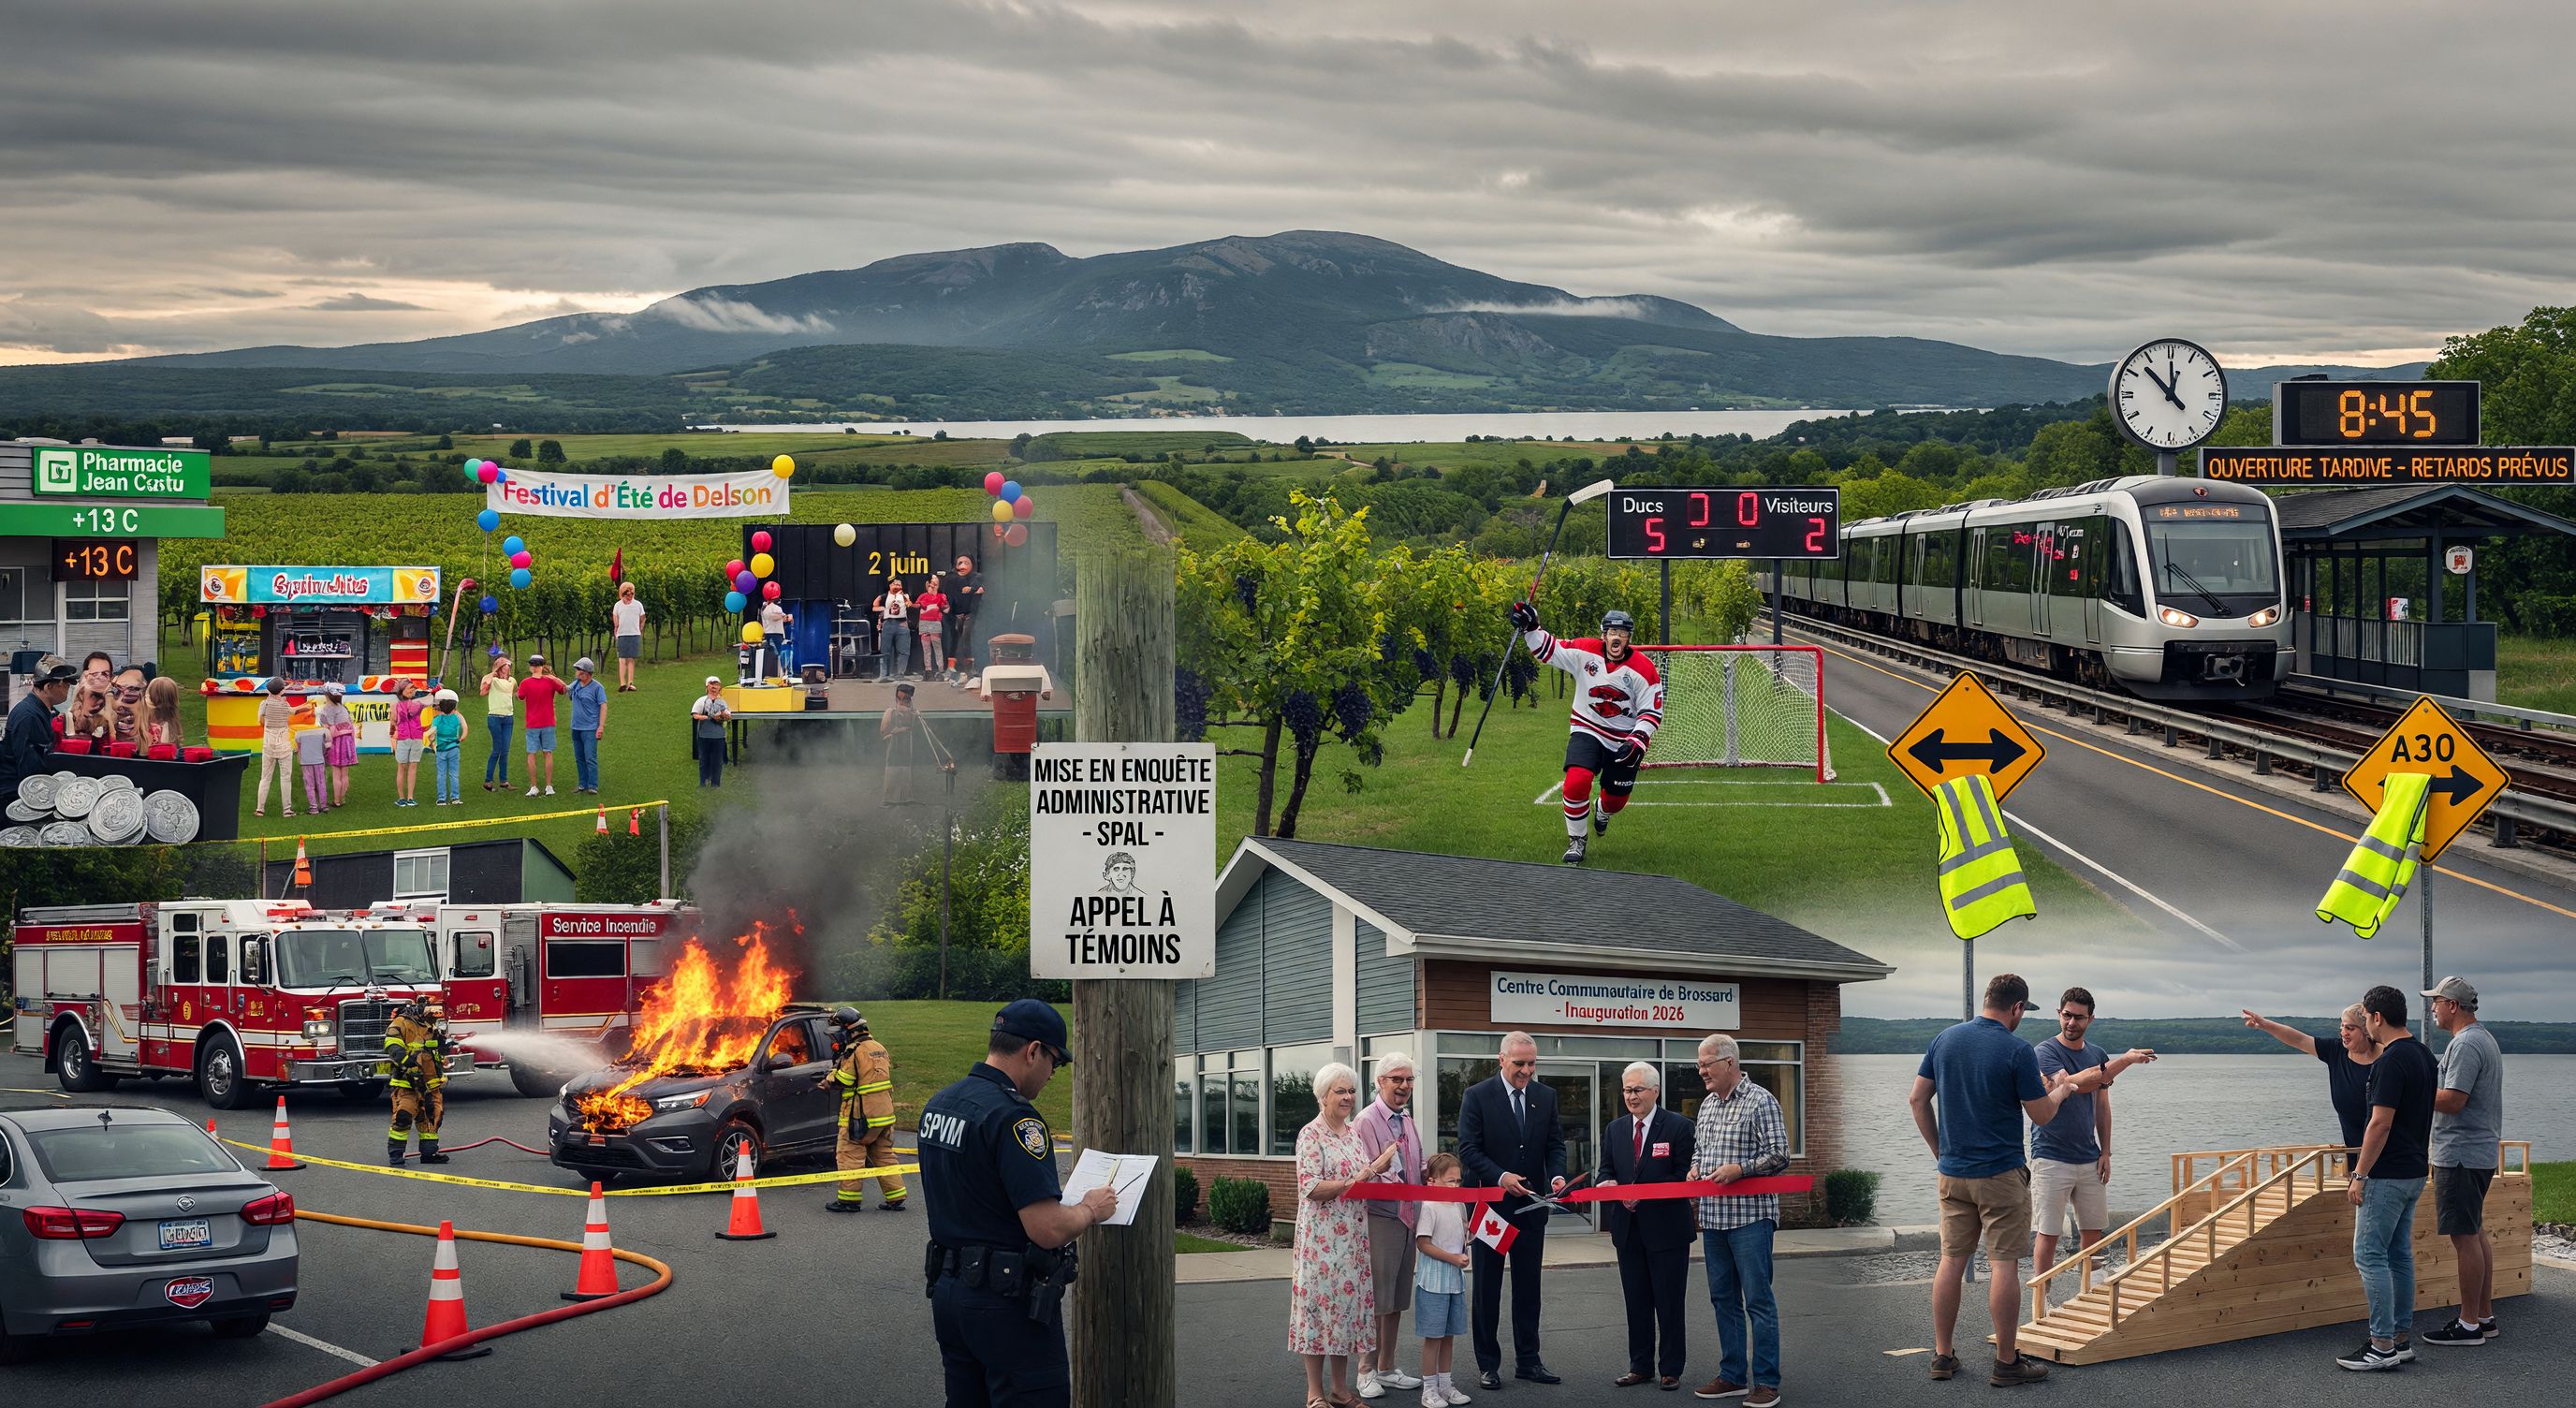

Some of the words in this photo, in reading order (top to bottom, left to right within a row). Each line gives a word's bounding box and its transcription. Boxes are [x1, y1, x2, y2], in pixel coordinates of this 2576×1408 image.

[2338, 389, 2437, 439] 8:45
[82, 451, 183, 474] Pharmacie
[2209, 457, 2312, 478] OUVERTURE
[2320, 456, 2393, 478] TARDIVE
[2411, 456, 2491, 477] RETARDS
[2498, 452, 2568, 478] PRÉVUS
[82, 472, 128, 491] Jean
[504, 480, 589, 507] Festival
[594, 480, 653, 509] d'Été
[659, 483, 687, 508] de
[694, 482, 772, 507] Delson
[1623, 497, 1663, 513] Ducs
[1764, 496, 1833, 514] Visiteurs
[72, 508, 115, 533] +13
[122, 508, 139, 533] C
[1646, 518, 1665, 551] 5
[1806, 517, 1825, 552] 2
[65, 546, 110, 577] +13
[116, 546, 133, 575] C
[869, 551, 882, 576] 2
[887, 550, 929, 581] juin
[2391, 733, 2455, 763] A30
[1034, 758, 1084, 783] MISE
[1090, 758, 1116, 783] EN
[1122, 754, 1211, 784] ENQUÊTE
[1036, 789, 1210, 814] ADMINISTRATIVE
[1097, 821, 1149, 846] SPAL
[1070, 896, 1151, 927] APPEL
[1158, 890, 1176, 927] À
[553, 917, 601, 933] Service
[606, 917, 656, 933] Incendie
[1065, 928, 1181, 965] TÉMOINS
[1498, 976, 1544, 995] Centre
[1659, 985, 1675, 1001] de
[1679, 985, 1734, 1003] Brossard
[1565, 1001, 1648, 1022] Inauguration
[1652, 1005, 1685, 1021] 2026
[920, 1112, 966, 1148] SPVM
